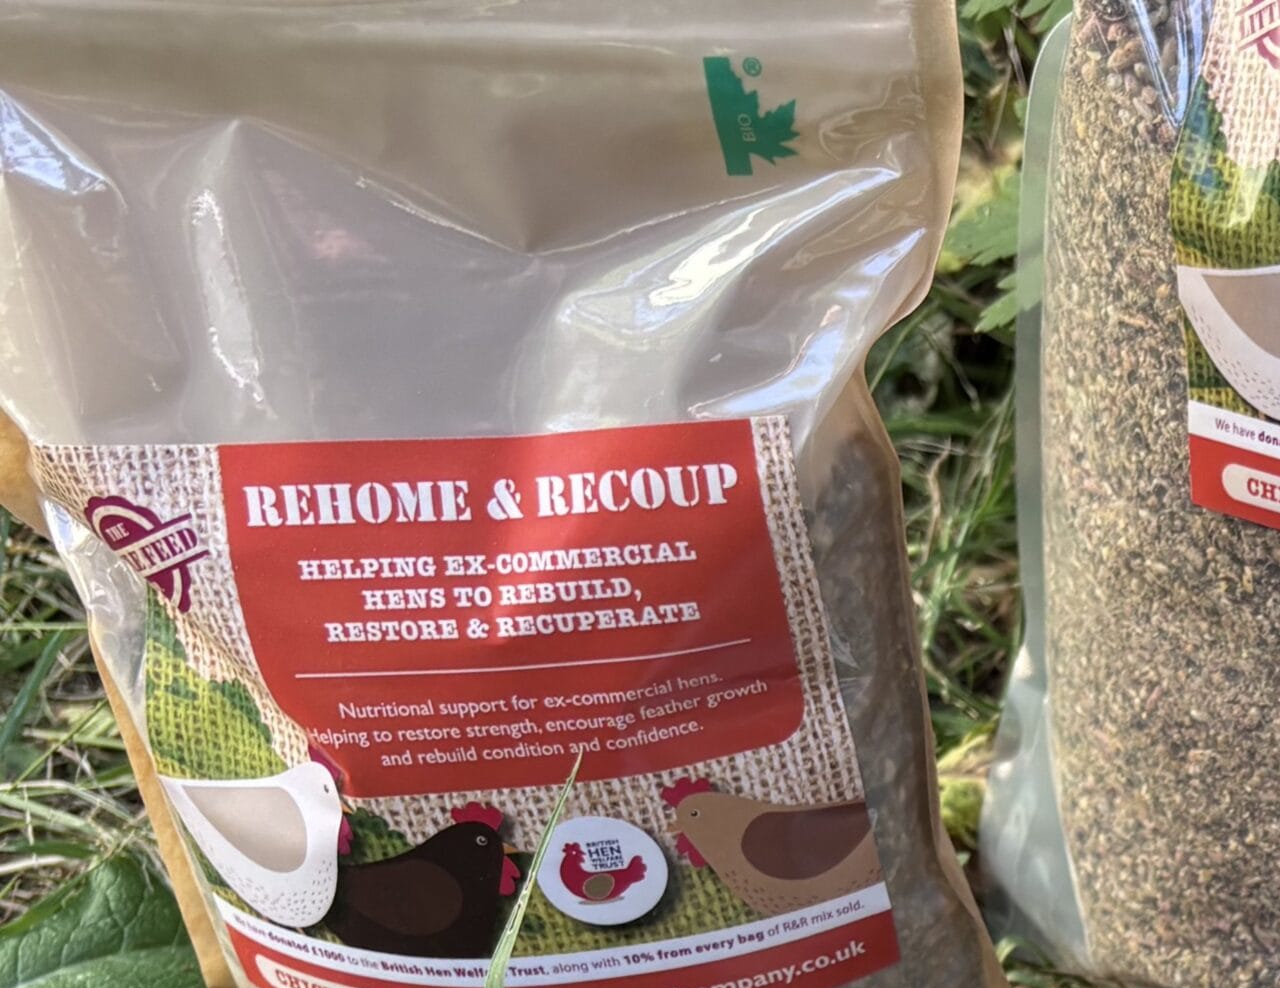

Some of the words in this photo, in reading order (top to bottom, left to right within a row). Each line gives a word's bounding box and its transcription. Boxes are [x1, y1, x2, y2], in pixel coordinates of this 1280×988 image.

[1214, 417, 1230, 432] We
[1232, 422, 1256, 440] have
[243, 481, 472, 527] REHOME
[487, 478, 524, 521] &
[535, 463, 738, 517] RECOUP
[105, 522, 130, 542] THE
[298, 556, 436, 580] HELPING
[443, 541, 697, 576] EX-COMMERCIAL
[361, 588, 446, 610] HENS
[453, 586, 492, 607] TO
[498, 577, 642, 606] REBUILD,
[324, 619, 459, 642] RESTORE
[466, 618, 490, 639] &
[496, 602, 701, 638] RECUPERATE
[338, 699, 434, 719] Nutritional
[439, 699, 508, 719] support
[511, 695, 538, 711] for
[543, 679, 672, 708] ex-commercial
[677, 672, 724, 690] hens.
[373, 728, 392, 743] to
[397, 725, 461, 742] restore
[466, 718, 543, 739] strength,
[545, 712, 636, 732] encourage
[639, 696, 700, 720] feather
[706, 679, 768, 708] growth
[381, 749, 413, 767] and
[417, 746, 477, 765] rebuild
[483, 742, 564, 761] condition
[569, 736, 601, 754] and
[606, 719, 704, 751] confidence.
[585, 839, 619, 848] BRITISH
[587, 845, 622, 858] HEN
[592, 860, 625, 870] TRUST
[347, 955, 359, 966] to
[360, 956, 380, 970] the
[380, 961, 423, 976] British
[424, 966, 451, 977] Hen
[453, 966, 508, 979] Welf
[508, 965, 550, 978] Trust,
[552, 962, 588, 974] along
[592, 956, 621, 969] with
[624, 952, 655, 965] 10%
[657, 946, 692, 961] from
[695, 938, 735, 954] every
[737, 931, 766, 946] bag
[768, 924, 780, 937] of
[782, 917, 809, 933] R&R
[810, 910, 834, 926] mix
[836, 899, 865, 917] sold.
